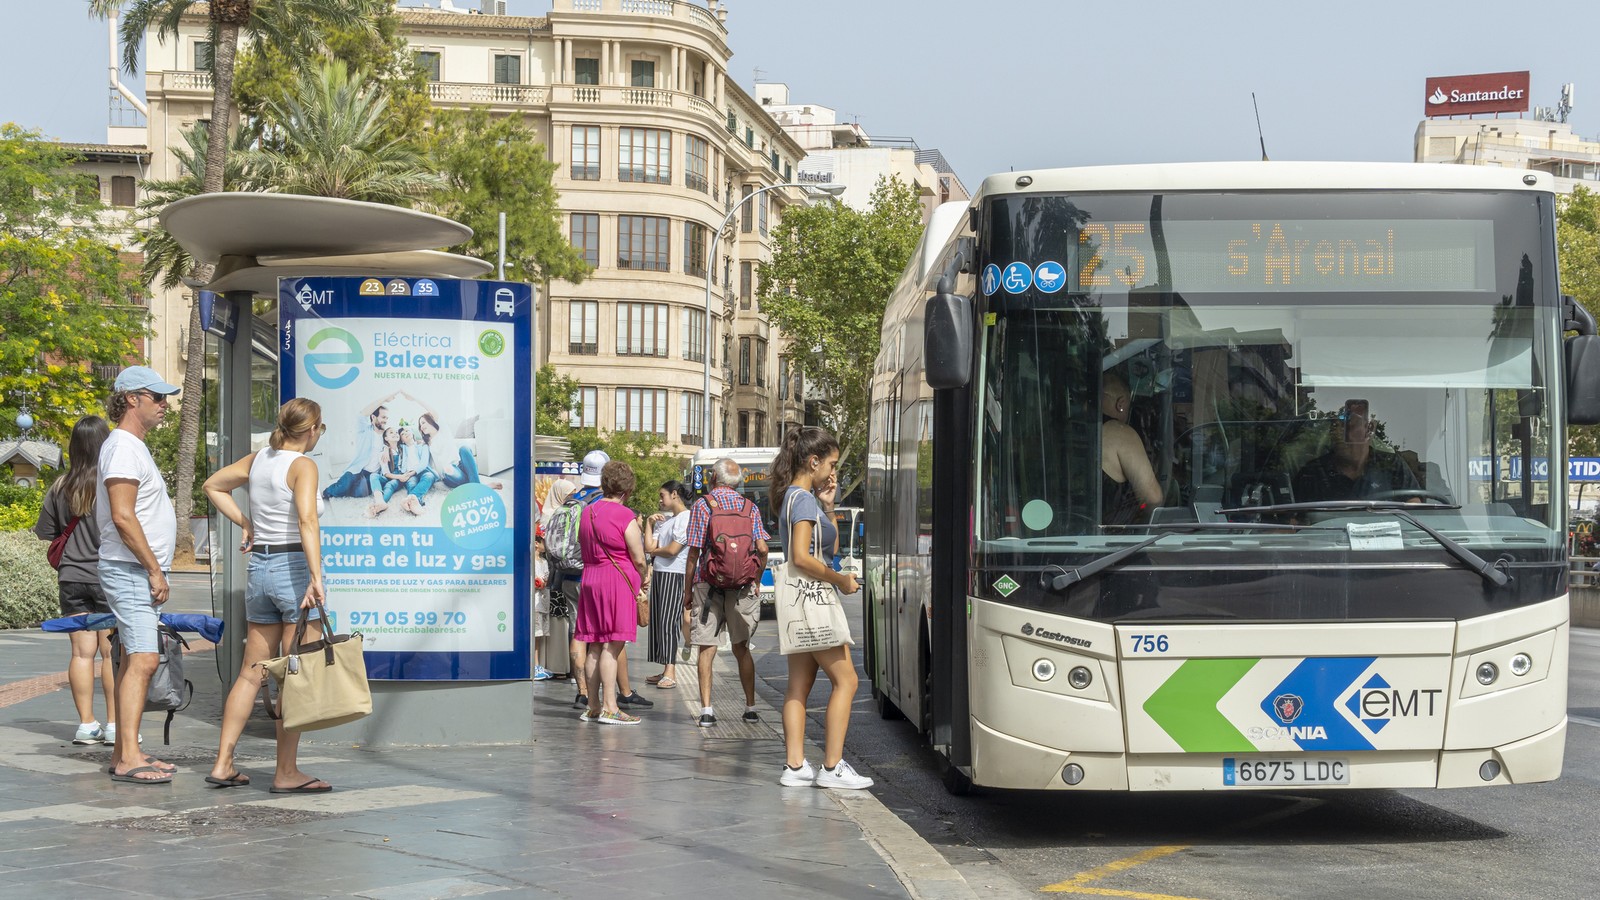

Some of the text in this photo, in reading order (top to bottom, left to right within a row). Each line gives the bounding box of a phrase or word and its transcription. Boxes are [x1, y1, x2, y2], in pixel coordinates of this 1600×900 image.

[1450, 85, 1524, 103] Santander
[797, 170, 833, 183] abadell
[1079, 223, 1394, 286] 25 s'Arenal
[365, 282, 433, 293] 23 25 35
[374, 331, 452, 348] Eléctrica
[374, 350, 480, 370] Baleares
[374, 371, 412, 380] NUESTRA
[414, 372, 431, 381] LUZ,
[445, 372, 480, 381] ENERGÍA
[447, 495, 494, 514] HASTA UN
[452, 503, 499, 528] 40%
[320, 529, 434, 547] horra en tu
[454, 521, 500, 538] DE AHORRO
[323, 550, 507, 571] ctura de luz y gas
[998, 581, 1014, 590] GNC
[349, 611, 467, 625] 971 05 99 70
[350, 626, 467, 634] www.electricabaleares.es
[1035, 627, 1092, 648] Castrosua
[1130, 634, 1169, 653] 756
[1247, 725, 1329, 740] SCANIA
[1240, 761, 1295, 781] 6675
[1303, 761, 1344, 781] LDC
